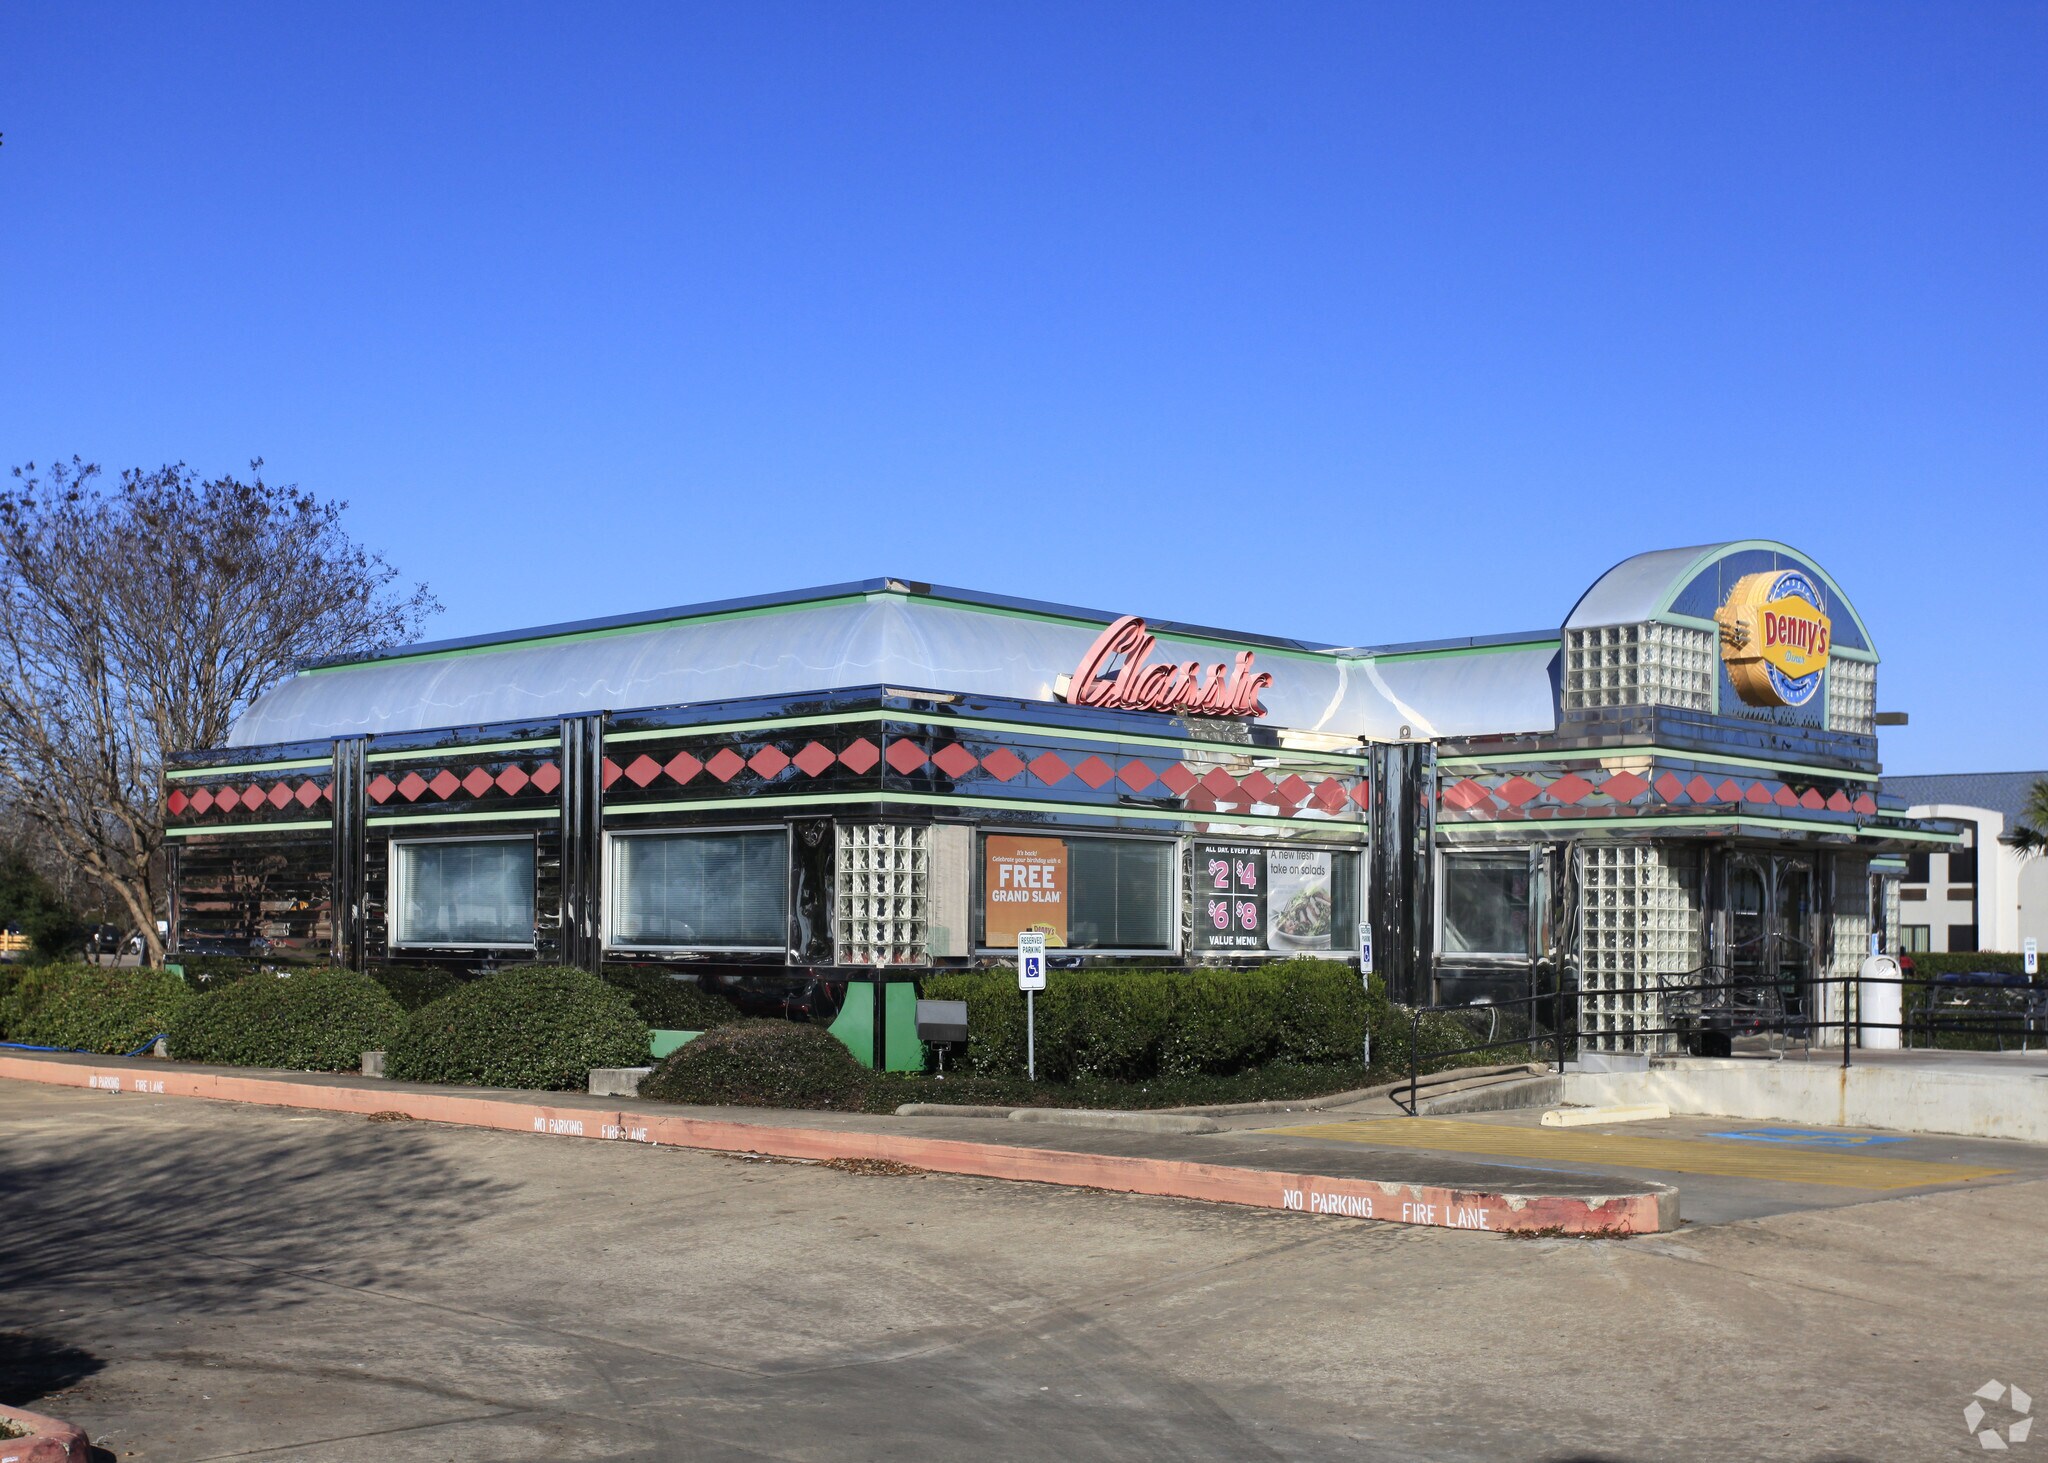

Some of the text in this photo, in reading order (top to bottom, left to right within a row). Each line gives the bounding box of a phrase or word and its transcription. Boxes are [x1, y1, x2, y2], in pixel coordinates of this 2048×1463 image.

[1764, 611, 1828, 657] Denny's
[1066, 615, 1274, 719] Classic
[1027, 857, 1046, 865] birthday
[1271, 850, 1277, 859] A
[1279, 851, 1295, 860] new
[999, 864, 1055, 889] FREE
[1208, 858, 1230, 889] $2
[1236, 860, 1257, 890] $4
[1271, 863, 1326, 876] take on salads
[992, 890, 1030, 902] GRAND
[1208, 900, 1258, 930] $6 $8
[1021, 936, 1043, 945] RESERVED
[1022, 946, 1041, 954] PARKING
[1209, 936, 1258, 946] VALUE MENU
[89, 1075, 164, 1094] NO PARKING FIRE LANE
[534, 1117, 546, 1133] NO
[549, 1119, 583, 1136] PARKING
[601, 1124, 620, 1140] FIRE
[1283, 1189, 1490, 1230] NO PARKING FIRE LANE
